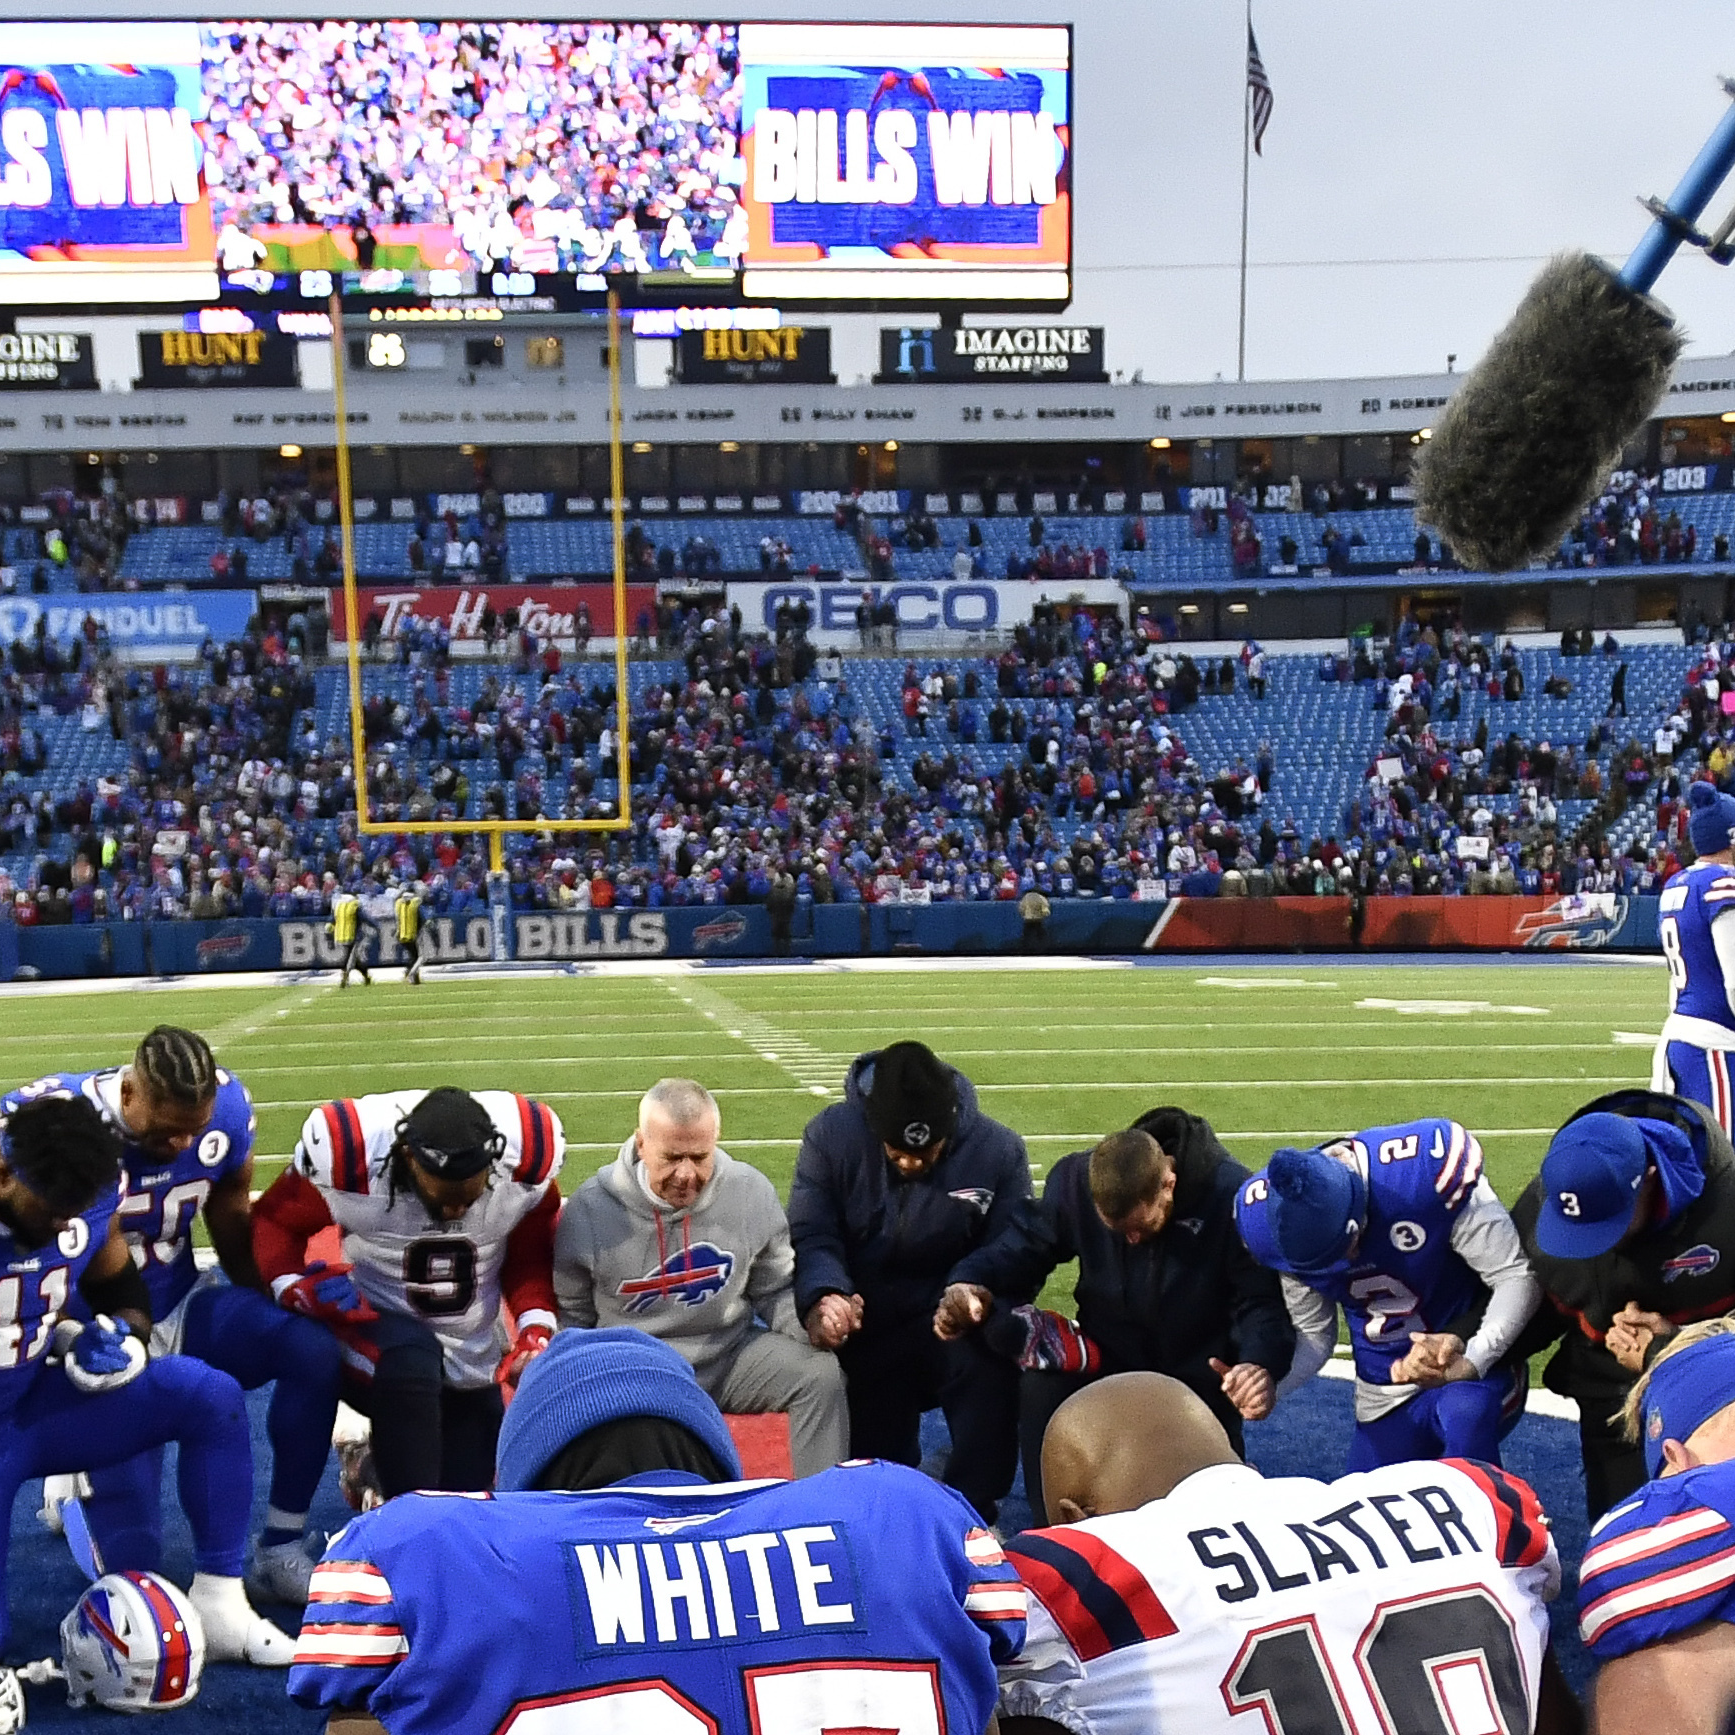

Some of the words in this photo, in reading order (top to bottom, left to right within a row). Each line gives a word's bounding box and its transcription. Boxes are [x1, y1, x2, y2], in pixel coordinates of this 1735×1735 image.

[56, 108, 200, 205] WIN
[753, 109, 918, 205] BILLS
[926, 109, 1057, 205] WIN
[161, 331, 263, 365] HUNT
[702, 327, 803, 361] HUNT
[954, 329, 1092, 354] IMAGINE
[973, 355, 1069, 372] STAFFING
[764, 585, 1000, 631] GECO
[279, 915, 490, 965] BUFALO
[517, 911, 668, 957] BILLS
[1559, 1192, 1581, 1217] 3
[1395, 1225, 1419, 1249] 3
[1188, 1485, 1484, 1604] SLATER
[575, 1526, 855, 1646] WHITE
